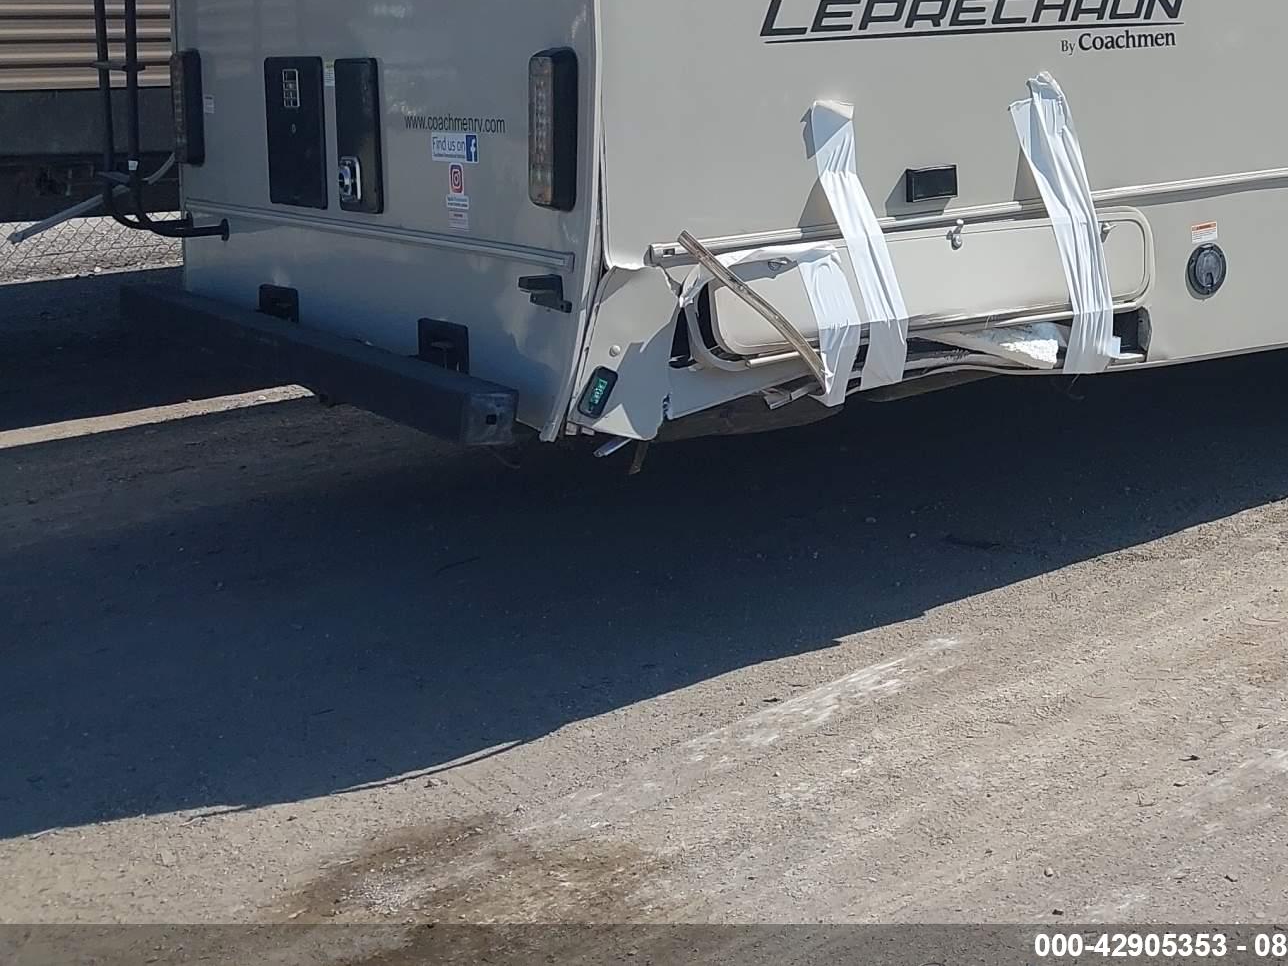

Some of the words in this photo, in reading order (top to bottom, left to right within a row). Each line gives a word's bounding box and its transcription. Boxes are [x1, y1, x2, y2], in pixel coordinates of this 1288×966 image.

[1060, 39, 1076, 55] By
[1077, 29, 1177, 52] Coachmen
[403, 114, 506, 134] www.coachmenrv.com
[432, 136, 447, 151] Find
[447, 140, 456, 151] us
[456, 140, 466, 152] on
